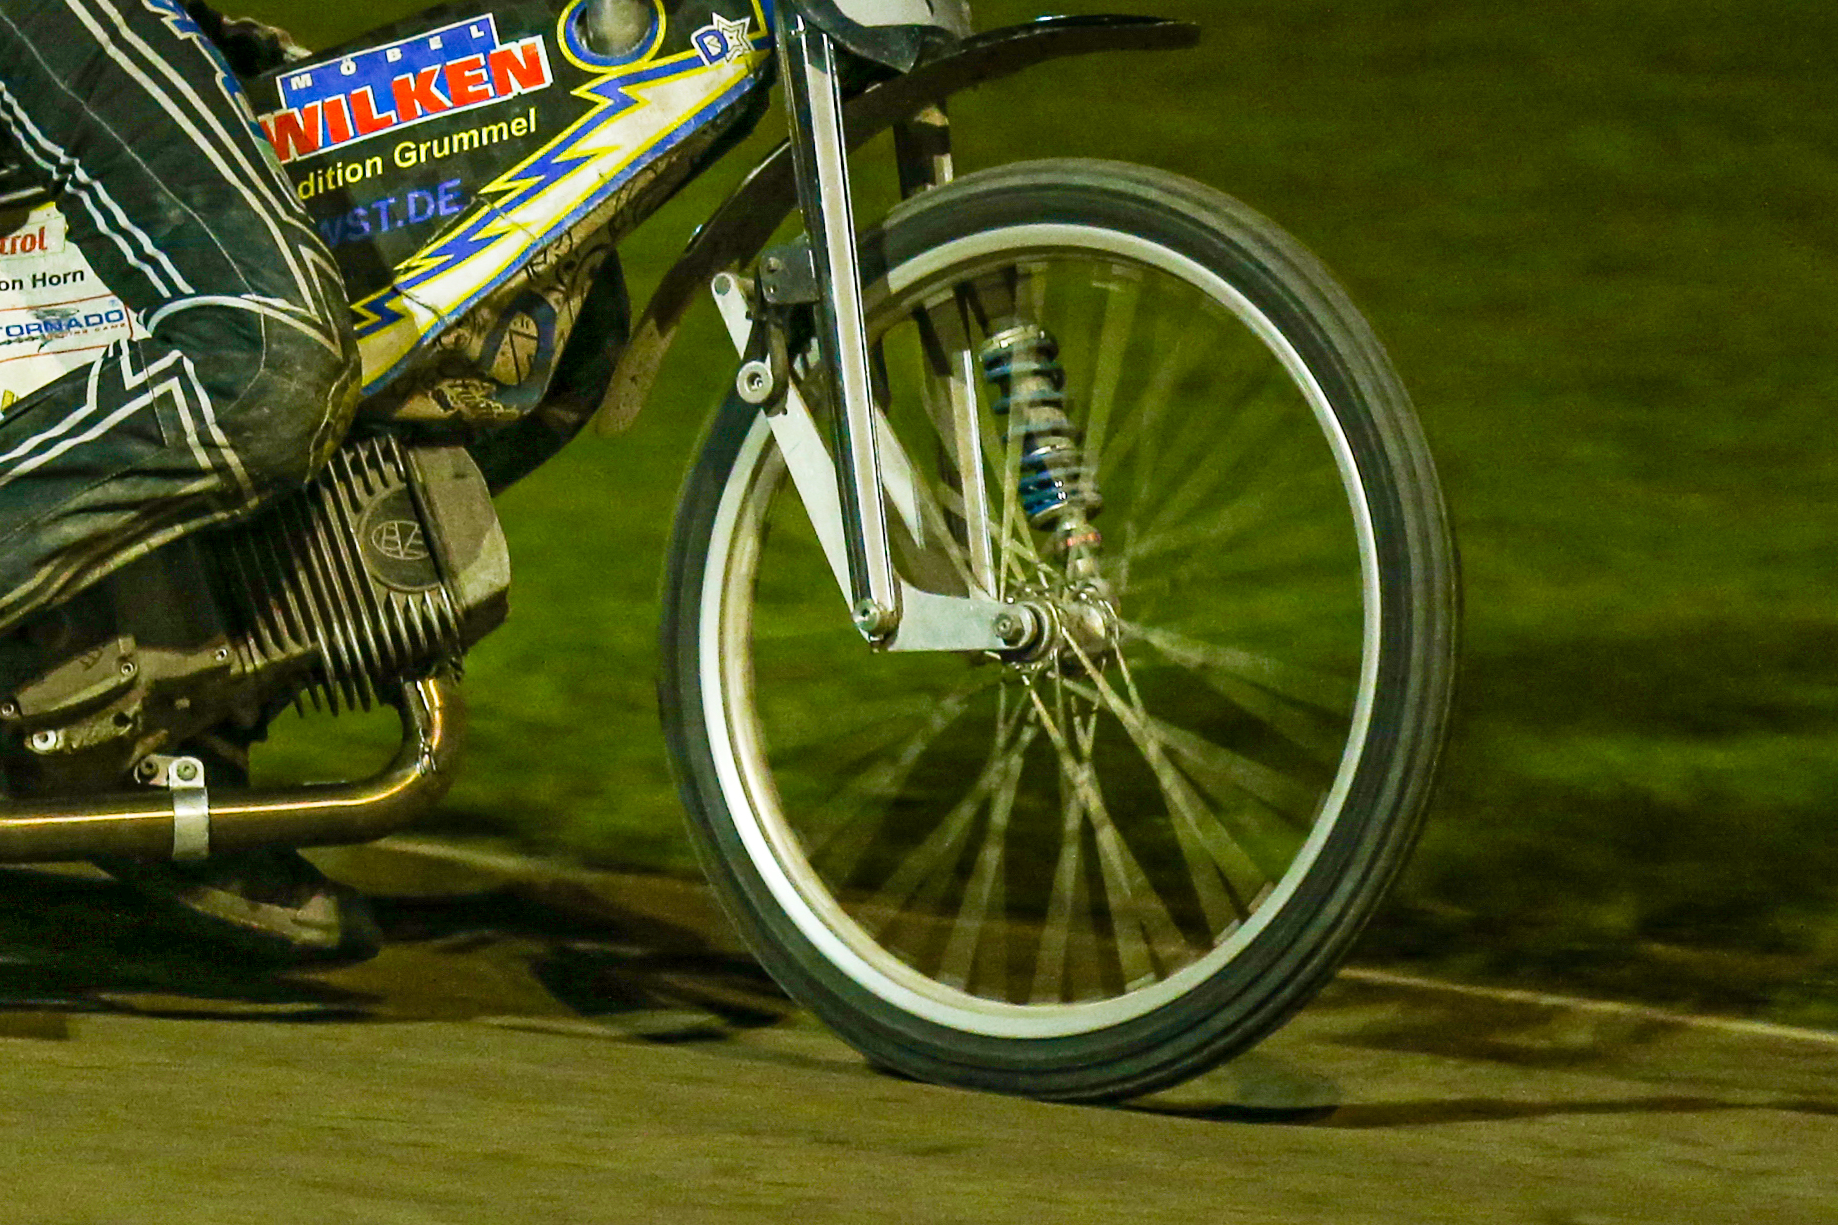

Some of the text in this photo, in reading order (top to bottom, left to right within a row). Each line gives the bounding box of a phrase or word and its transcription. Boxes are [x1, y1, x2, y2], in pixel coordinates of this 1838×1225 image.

[290, 24, 485, 90] MÖBEL
[258, 41, 548, 164] WILKEN
[393, 108, 537, 169] Grummel
[31, 269, 84, 288] Horn
